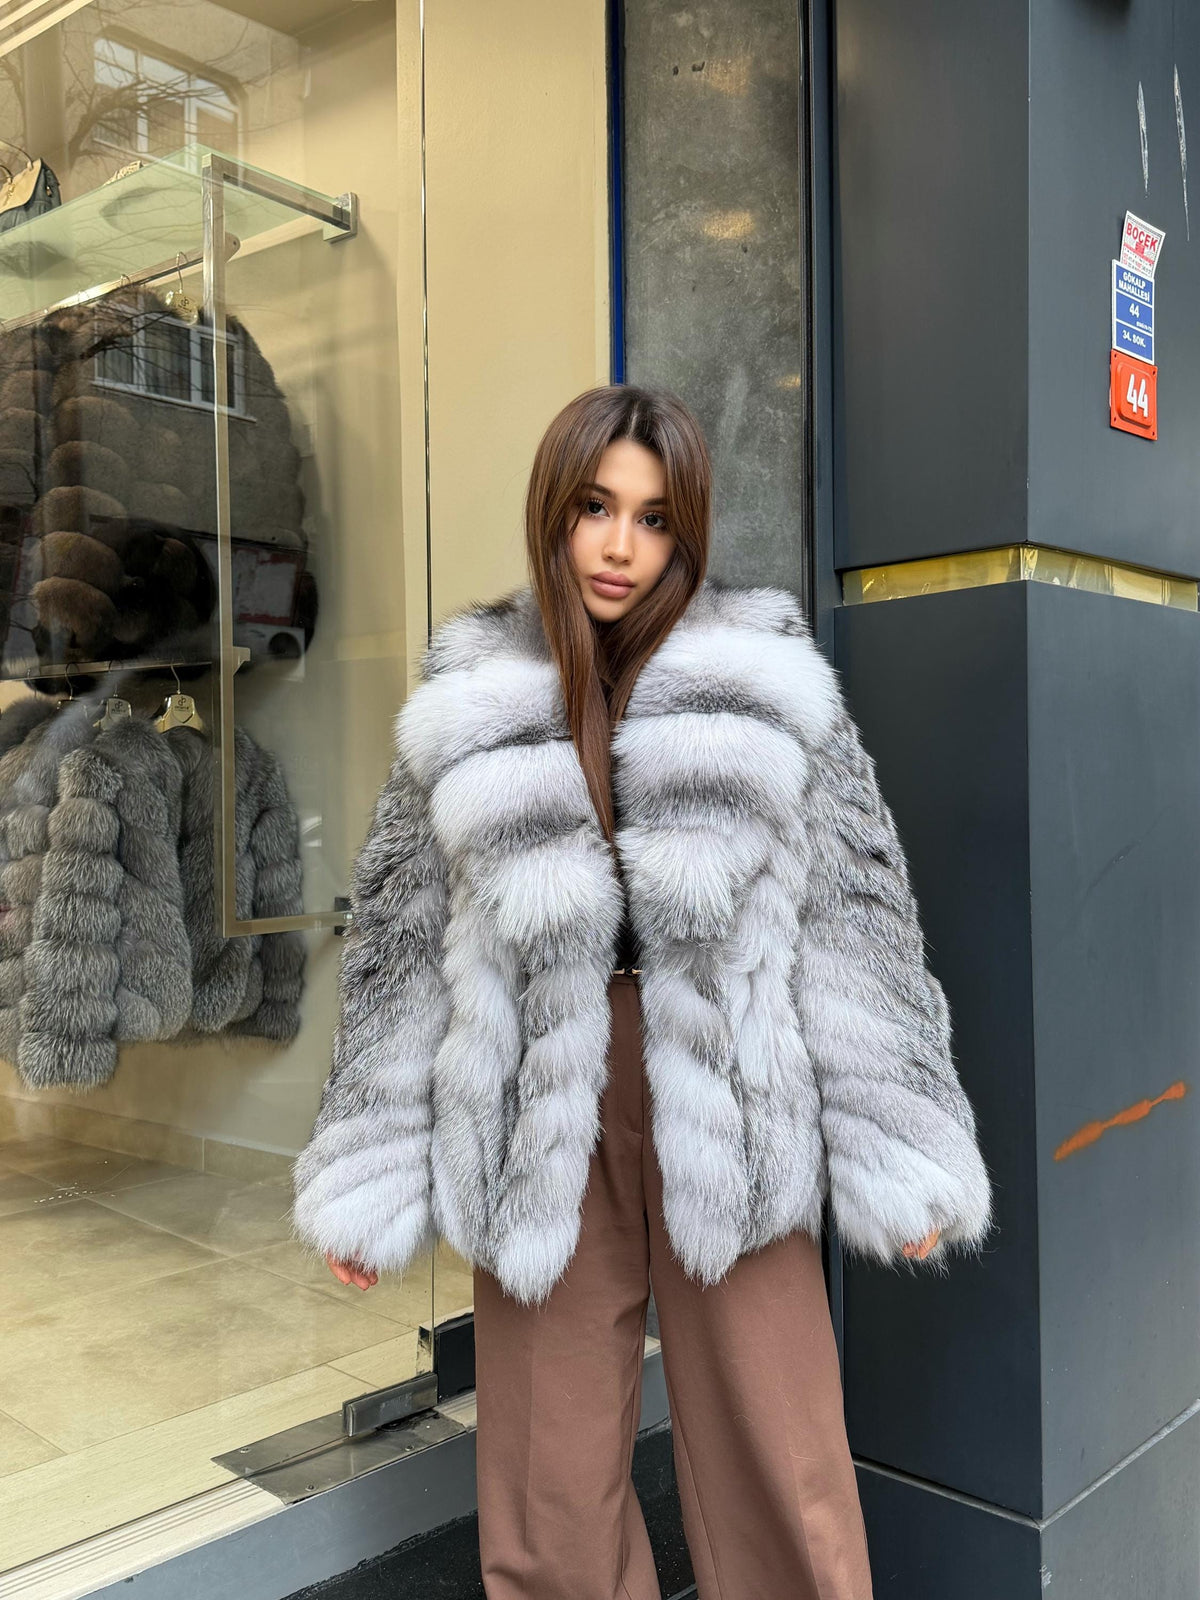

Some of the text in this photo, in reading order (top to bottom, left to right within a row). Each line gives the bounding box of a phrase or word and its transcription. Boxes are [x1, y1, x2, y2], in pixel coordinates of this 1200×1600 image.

[1122, 270, 1146, 290] GÖKALP
[1118, 279, 1150, 302] MAHALLESİ
[1129, 303, 1140, 318] 44
[1132, 333, 1147, 348] SOK.
[1126, 373, 1149, 418] 44
